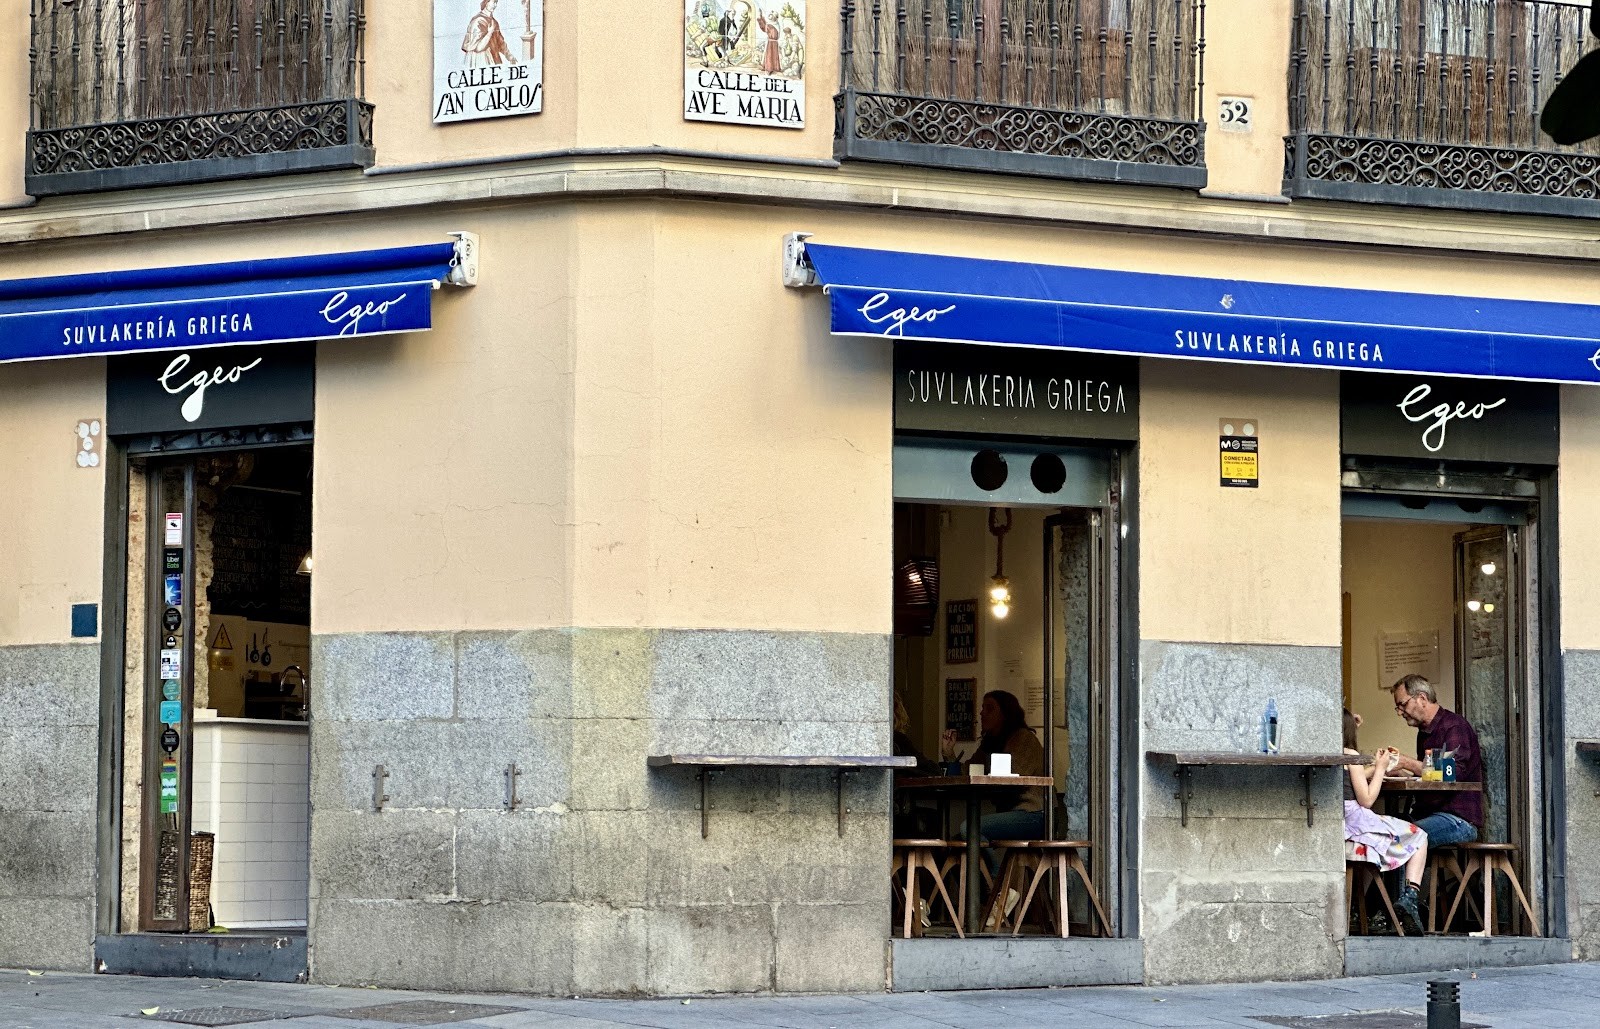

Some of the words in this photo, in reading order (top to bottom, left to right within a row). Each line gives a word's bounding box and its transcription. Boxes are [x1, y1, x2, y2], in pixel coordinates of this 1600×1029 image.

[448, 66, 503, 89] CALLE
[508, 65, 529, 80] DE
[698, 70, 761, 92] CALLE
[764, 77, 793, 93] DEL
[434, 91, 465, 119] SAN
[475, 83, 542, 111] CARLOS
[686, 90, 728, 115] AVE
[737, 94, 804, 122] MARIA
[1220, 99, 1248, 124] 32
[63, 315, 176, 345] SUVLAKERÍA
[187, 313, 253, 336] GRIEGA
[1175, 330, 1300, 356] SUVLAKERÍA
[1313, 340, 1383, 362] GRIEGA
[908, 369, 1035, 409] SUVLAKERIA
[1048, 378, 1126, 414] GRIEGA
[956, 614, 967, 623] DE
[1446, 764, 1453, 776] 8
